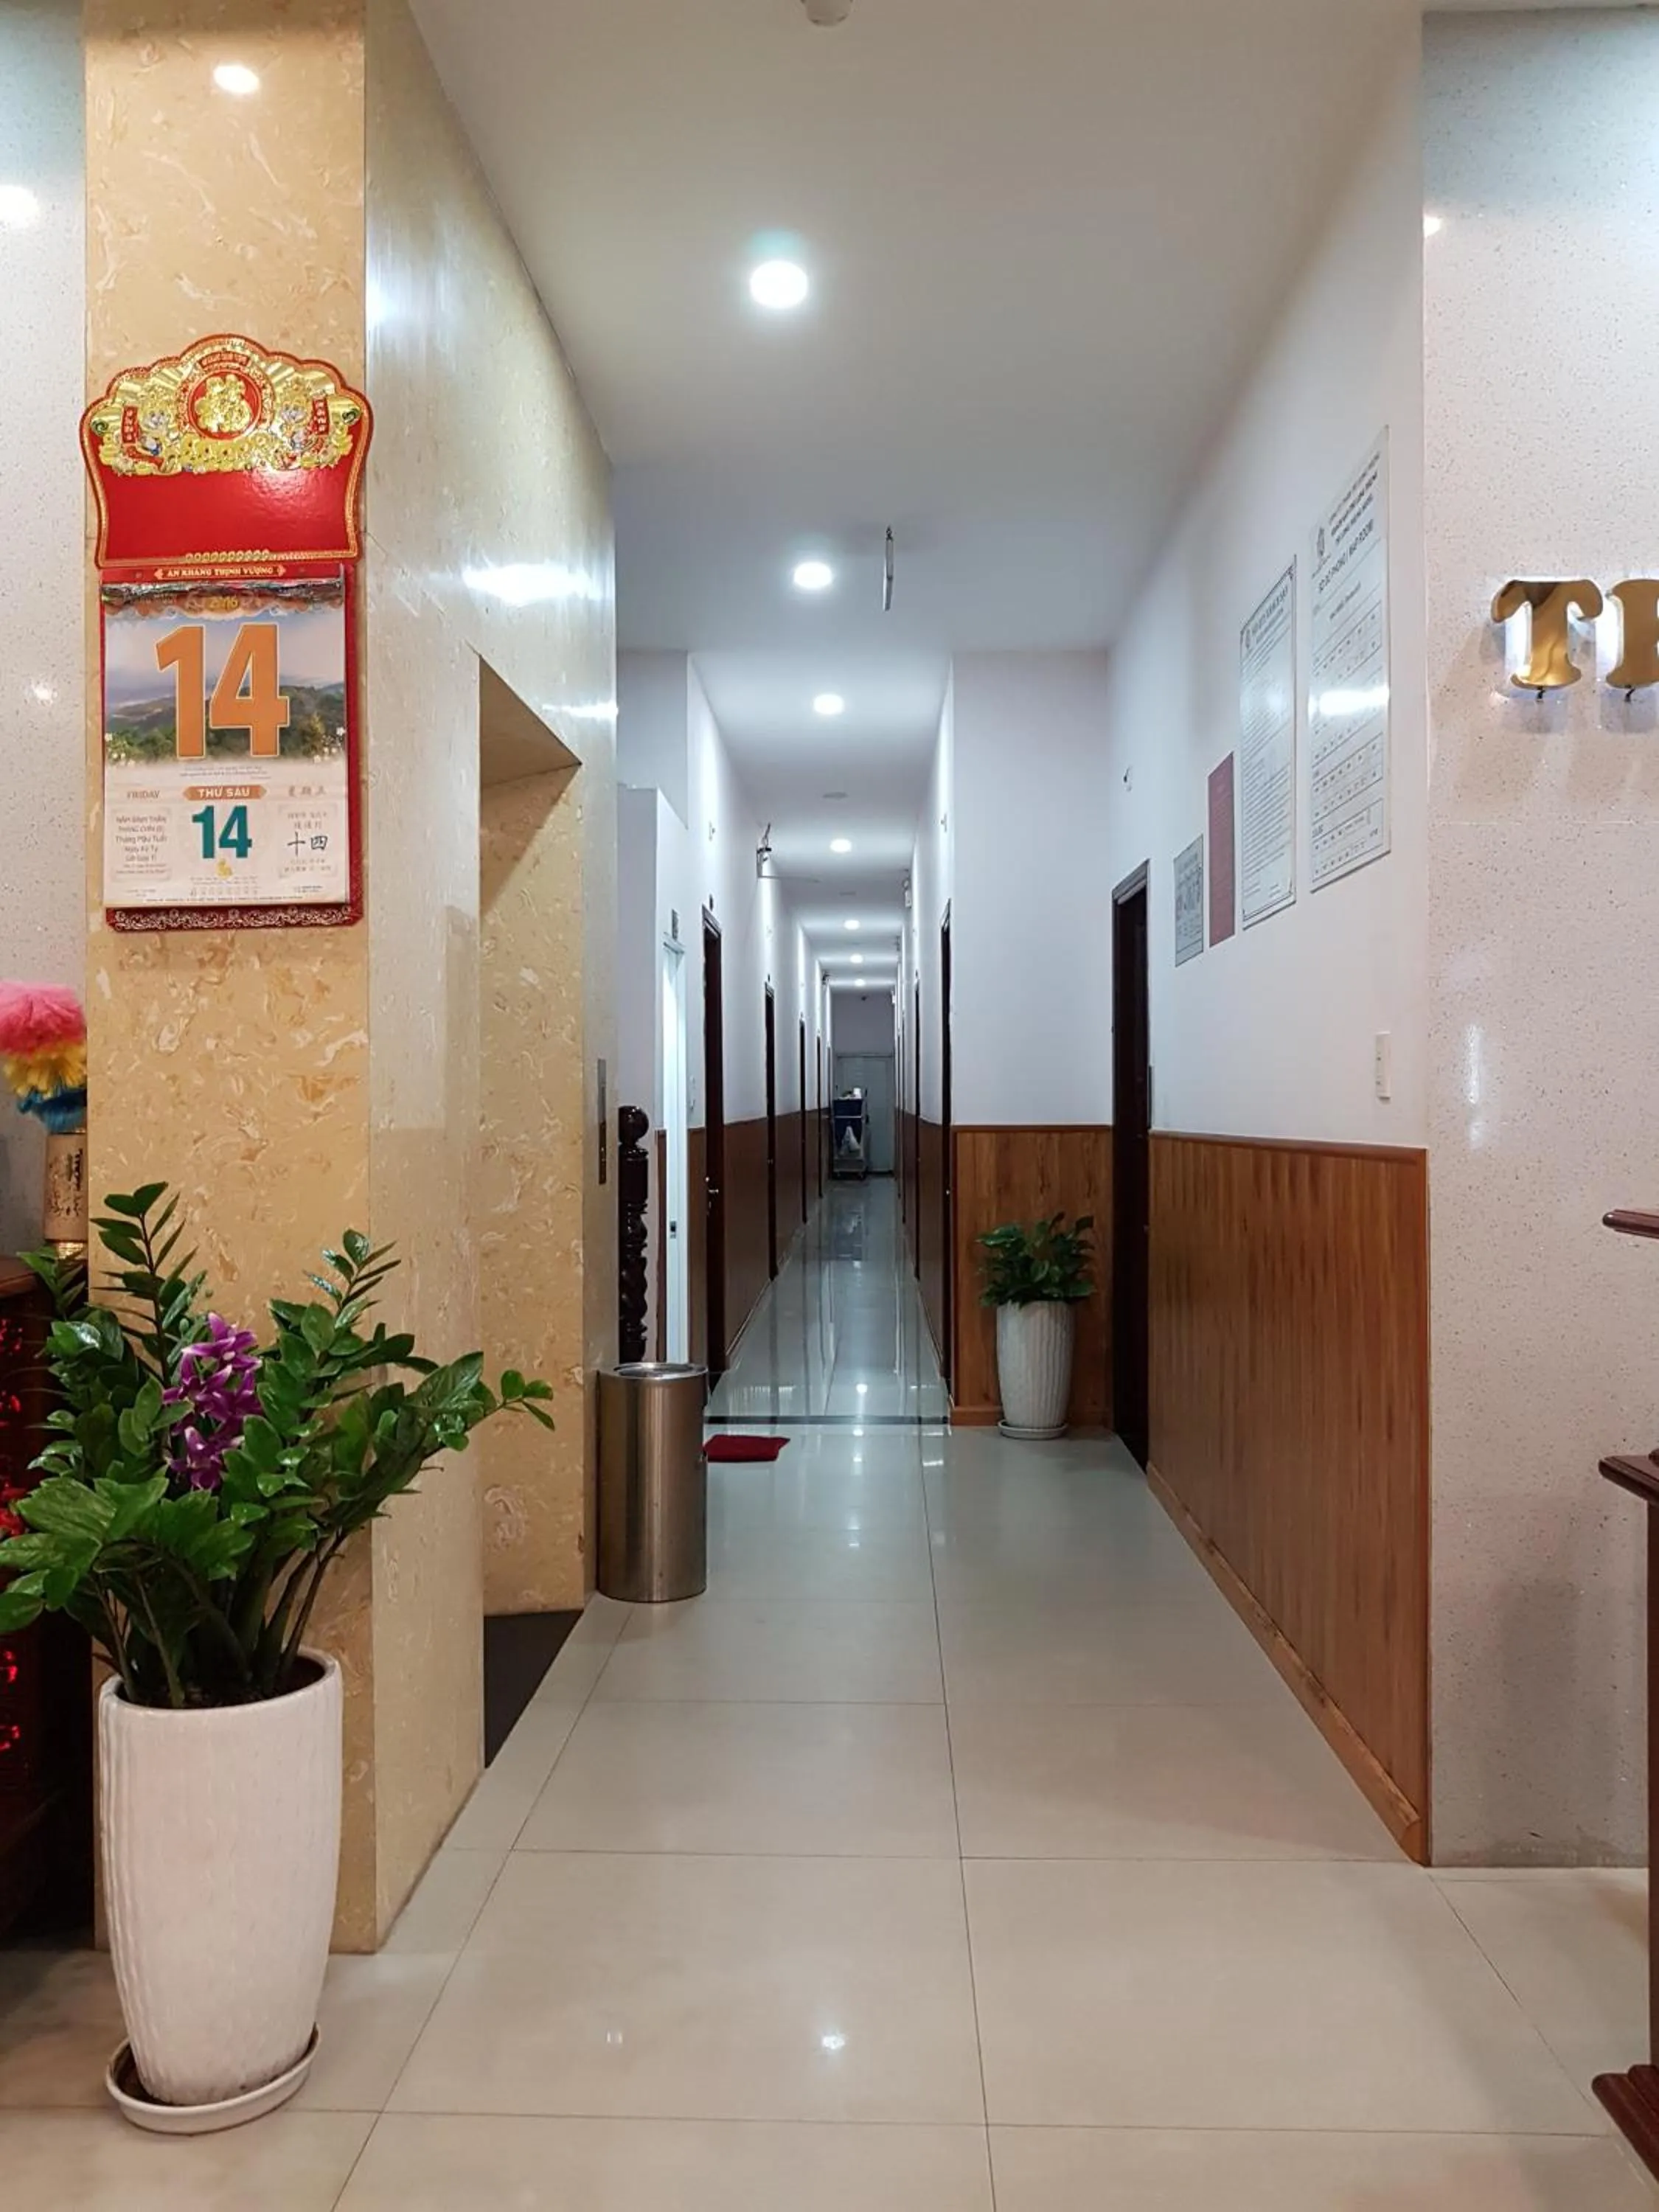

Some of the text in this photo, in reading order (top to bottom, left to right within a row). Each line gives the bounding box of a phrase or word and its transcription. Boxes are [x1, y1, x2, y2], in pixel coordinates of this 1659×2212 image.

[167, 569, 180, 577] AN
[181, 568, 212, 577] KHANG
[156, 623, 290, 759] 14
[192, 804, 252, 859] 14
[287, 831, 328, 857] 十四
